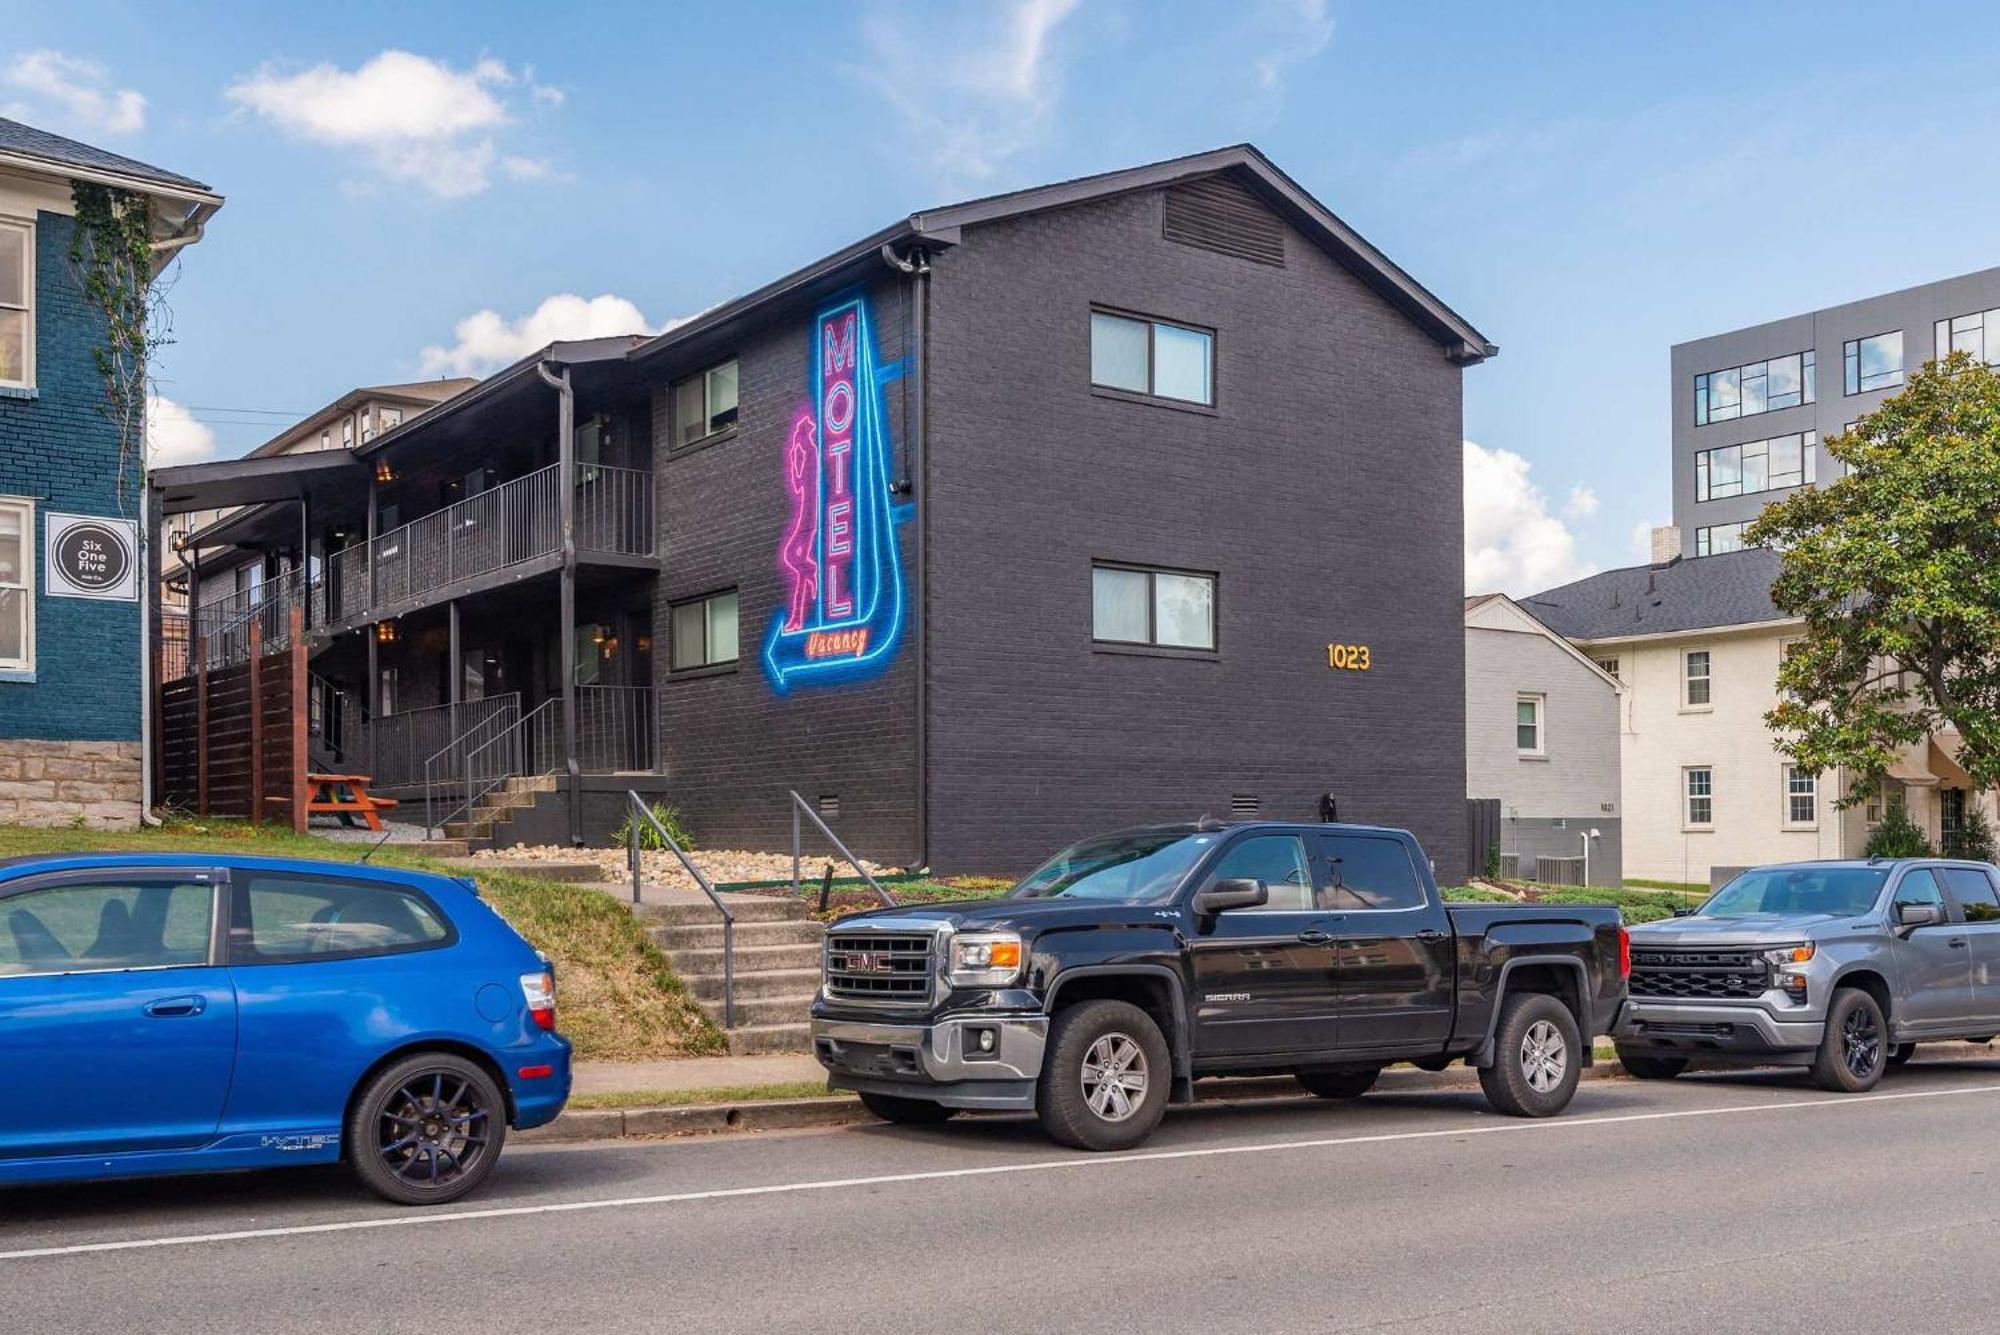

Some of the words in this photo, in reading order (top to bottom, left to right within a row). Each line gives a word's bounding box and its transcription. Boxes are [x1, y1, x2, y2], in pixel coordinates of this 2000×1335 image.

[824, 313, 855, 618] MOTEL
[82, 540, 102, 551] Six
[78, 550, 107, 562] One
[79, 561, 106, 572] Five
[808, 629, 867, 657] Vacancy
[1328, 643, 1370, 670] 1023
[847, 952, 891, 973] GMC
[1631, 953, 1752, 964] HEVROLET
[1205, 993, 1250, 1001] SIERRA
